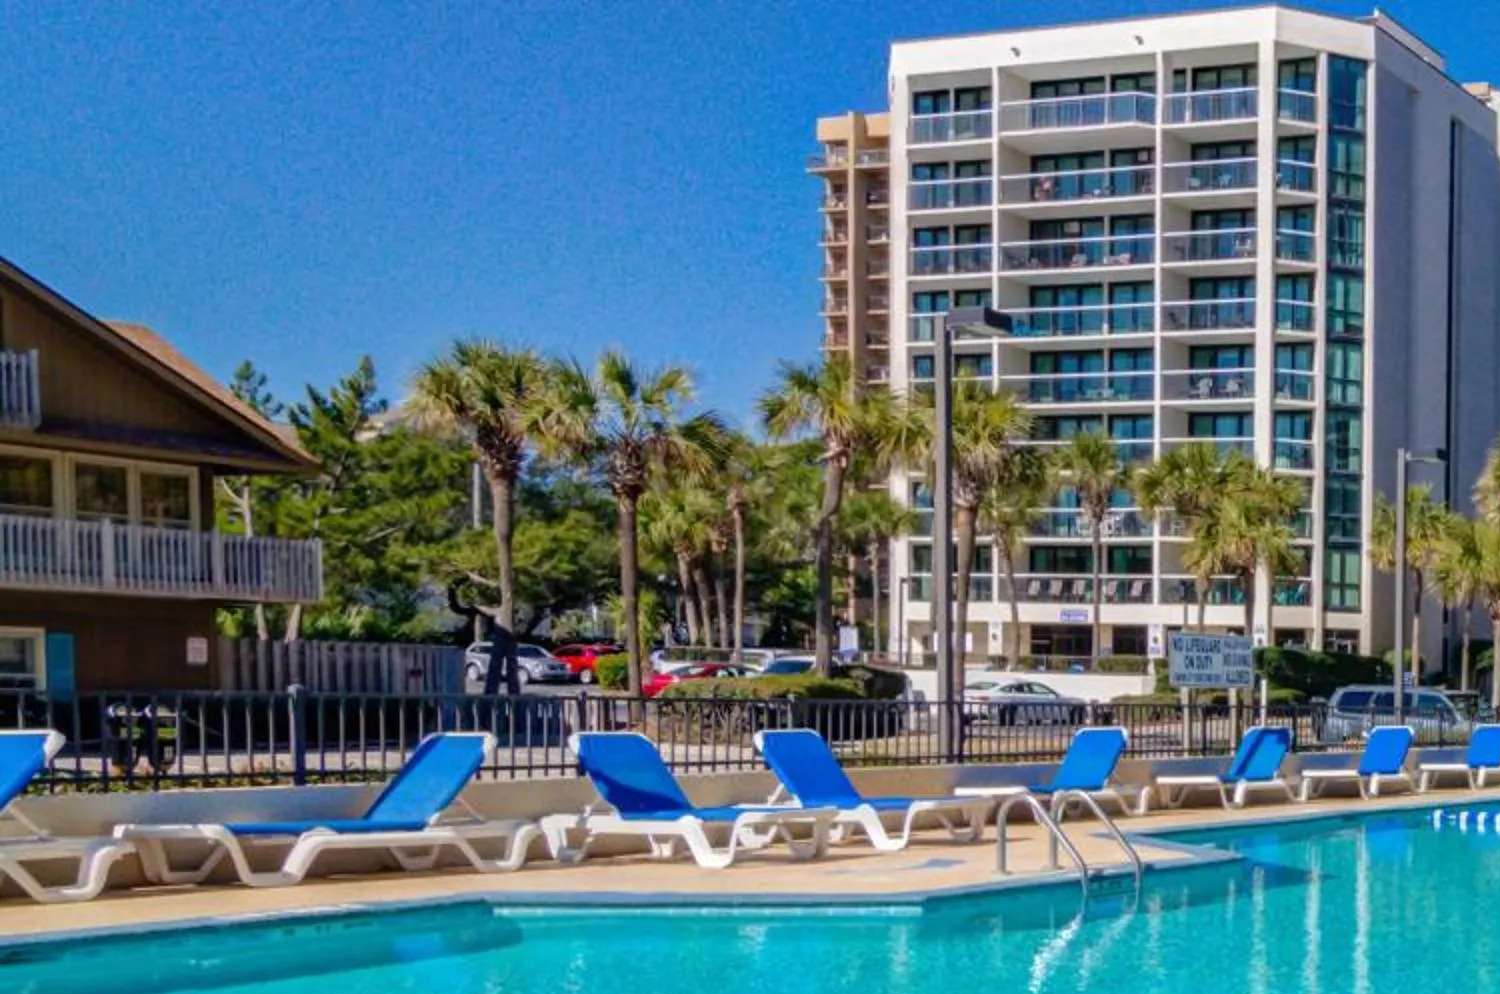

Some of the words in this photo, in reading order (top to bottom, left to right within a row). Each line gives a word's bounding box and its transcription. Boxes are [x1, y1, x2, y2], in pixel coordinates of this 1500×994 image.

[1172, 637, 1184, 652] NO
[1186, 637, 1220, 653] LIFEGUARD
[1184, 655, 1195, 670] ON
[1196, 655, 1212, 670] DUTY
